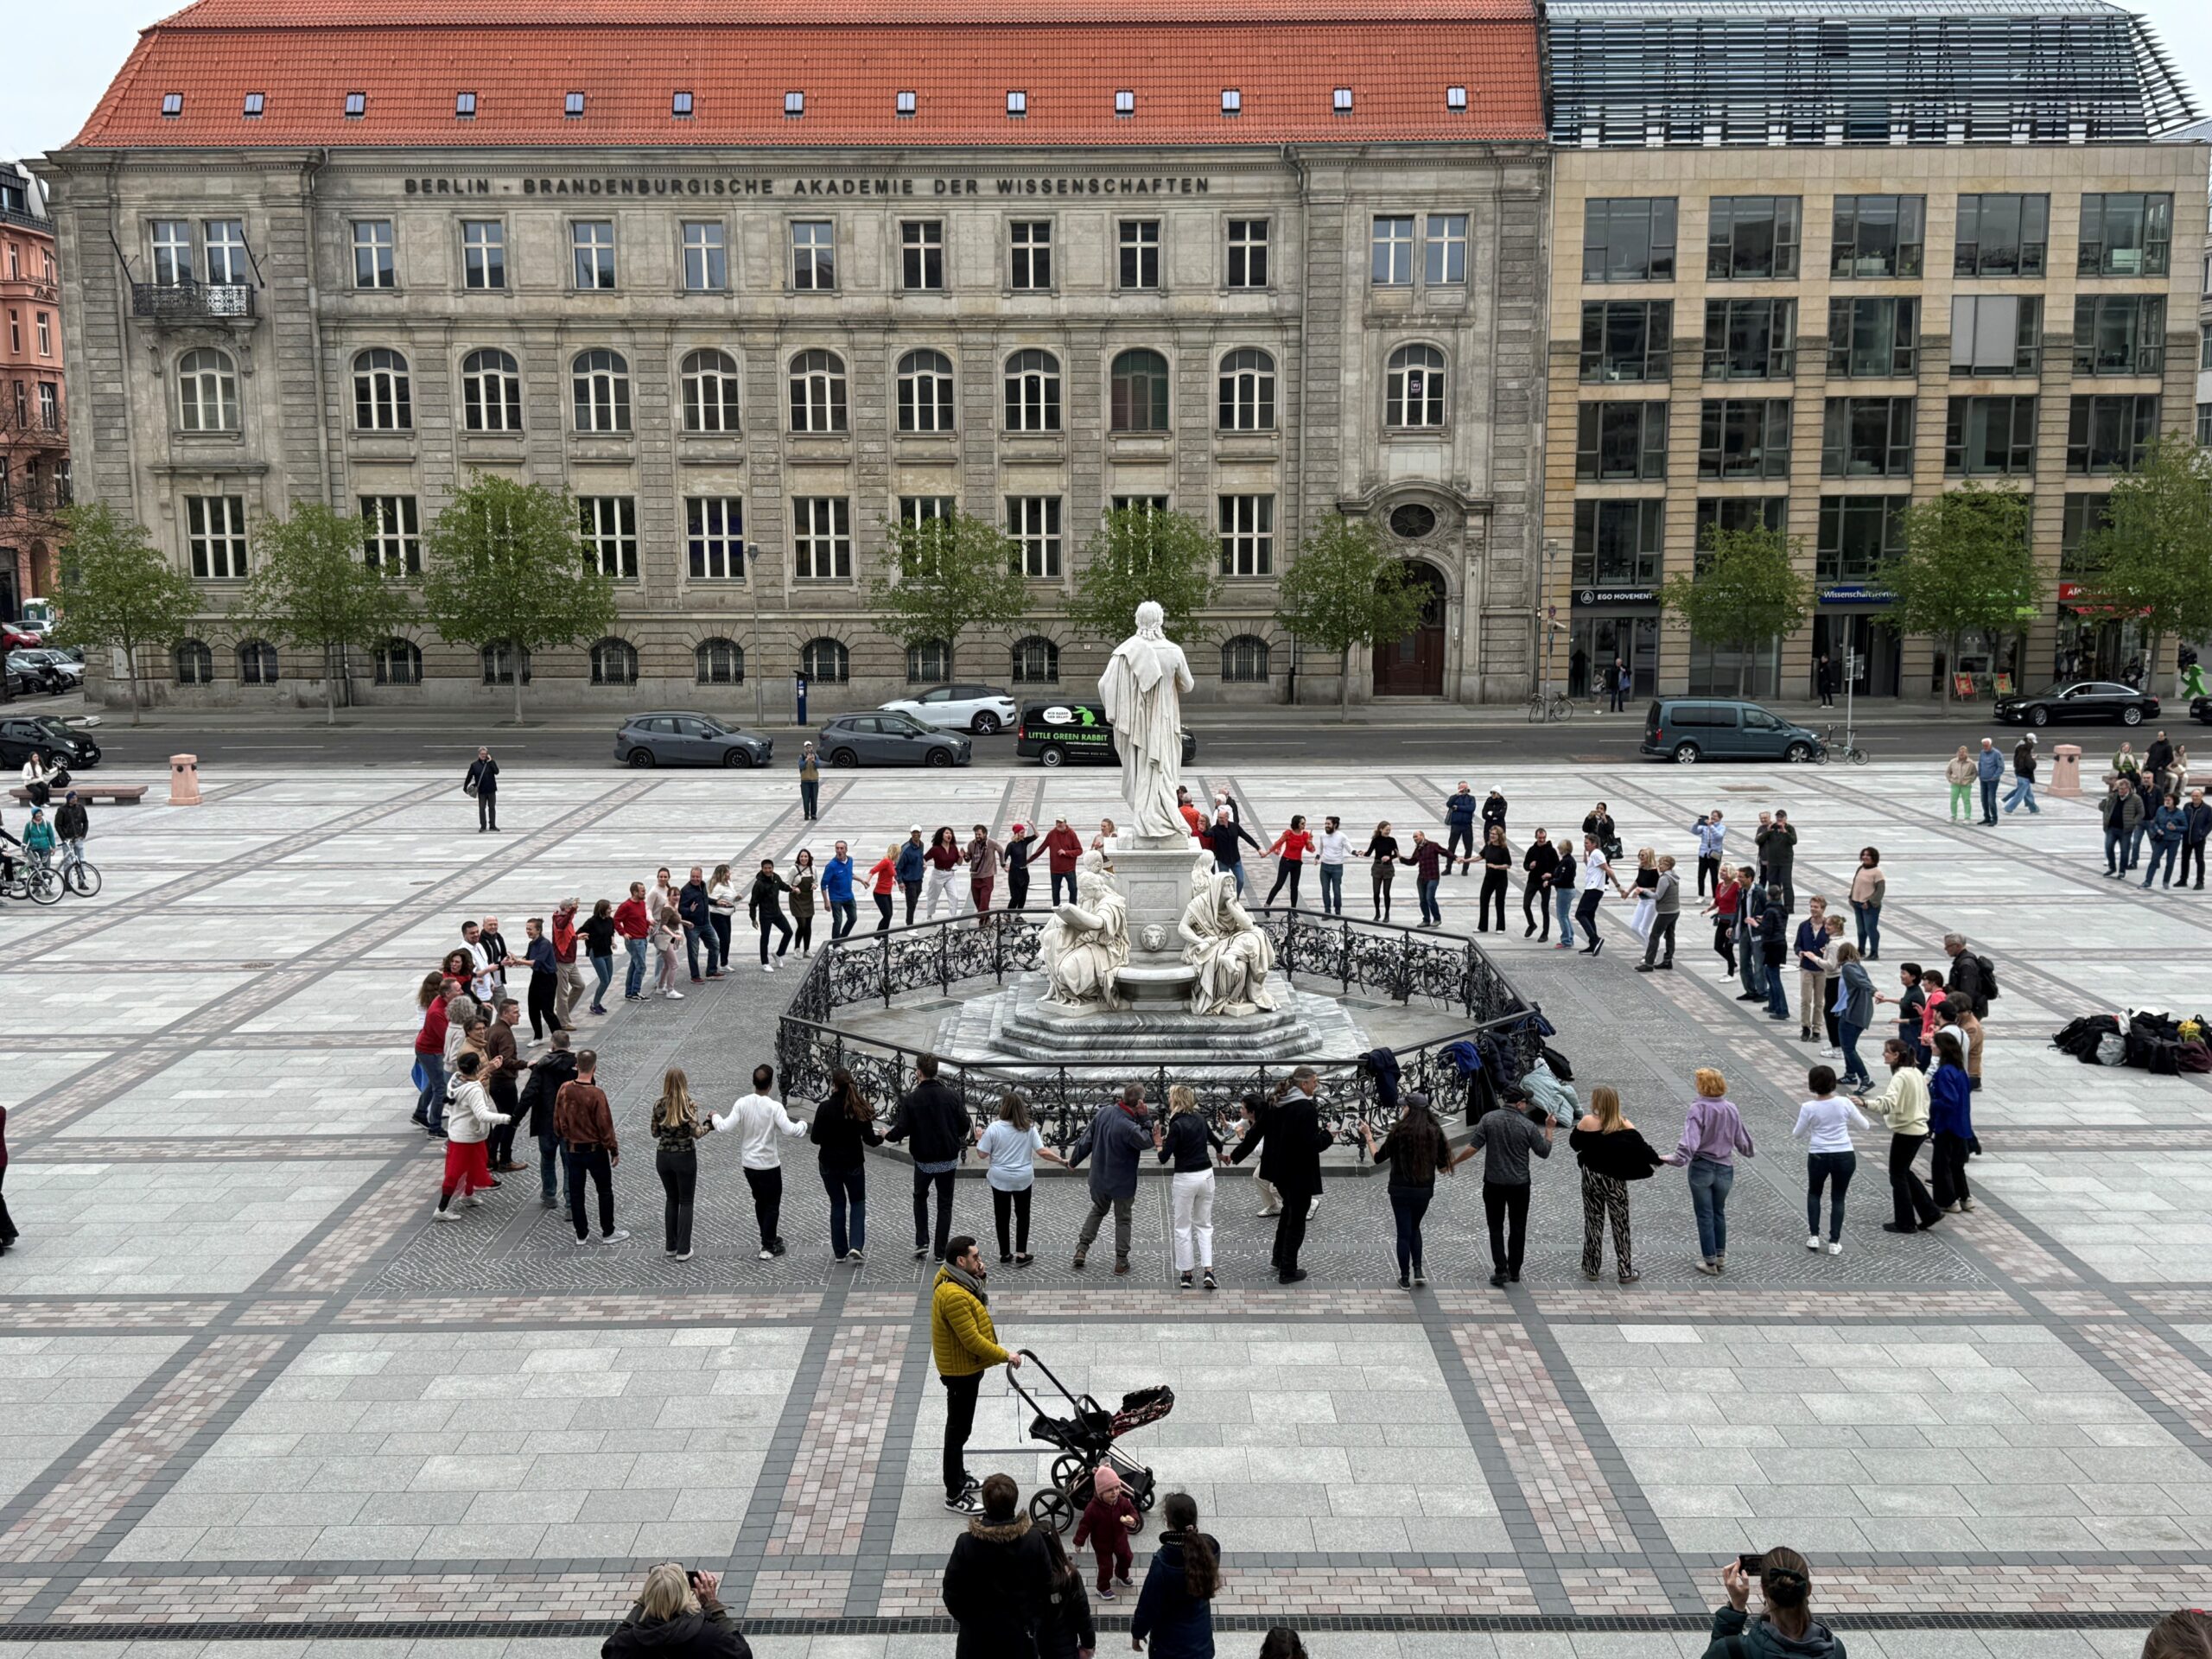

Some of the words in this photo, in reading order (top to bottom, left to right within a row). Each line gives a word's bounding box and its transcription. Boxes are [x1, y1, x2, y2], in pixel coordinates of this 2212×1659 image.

[404, 179, 489, 194] BERLIN
[524, 179, 772, 194] BRANDENBURGISCHE
[794, 179, 913, 194] AKADEMIE
[934, 179, 978, 194] DER
[996, 178, 1208, 194] WISSENSCHAFTEN
